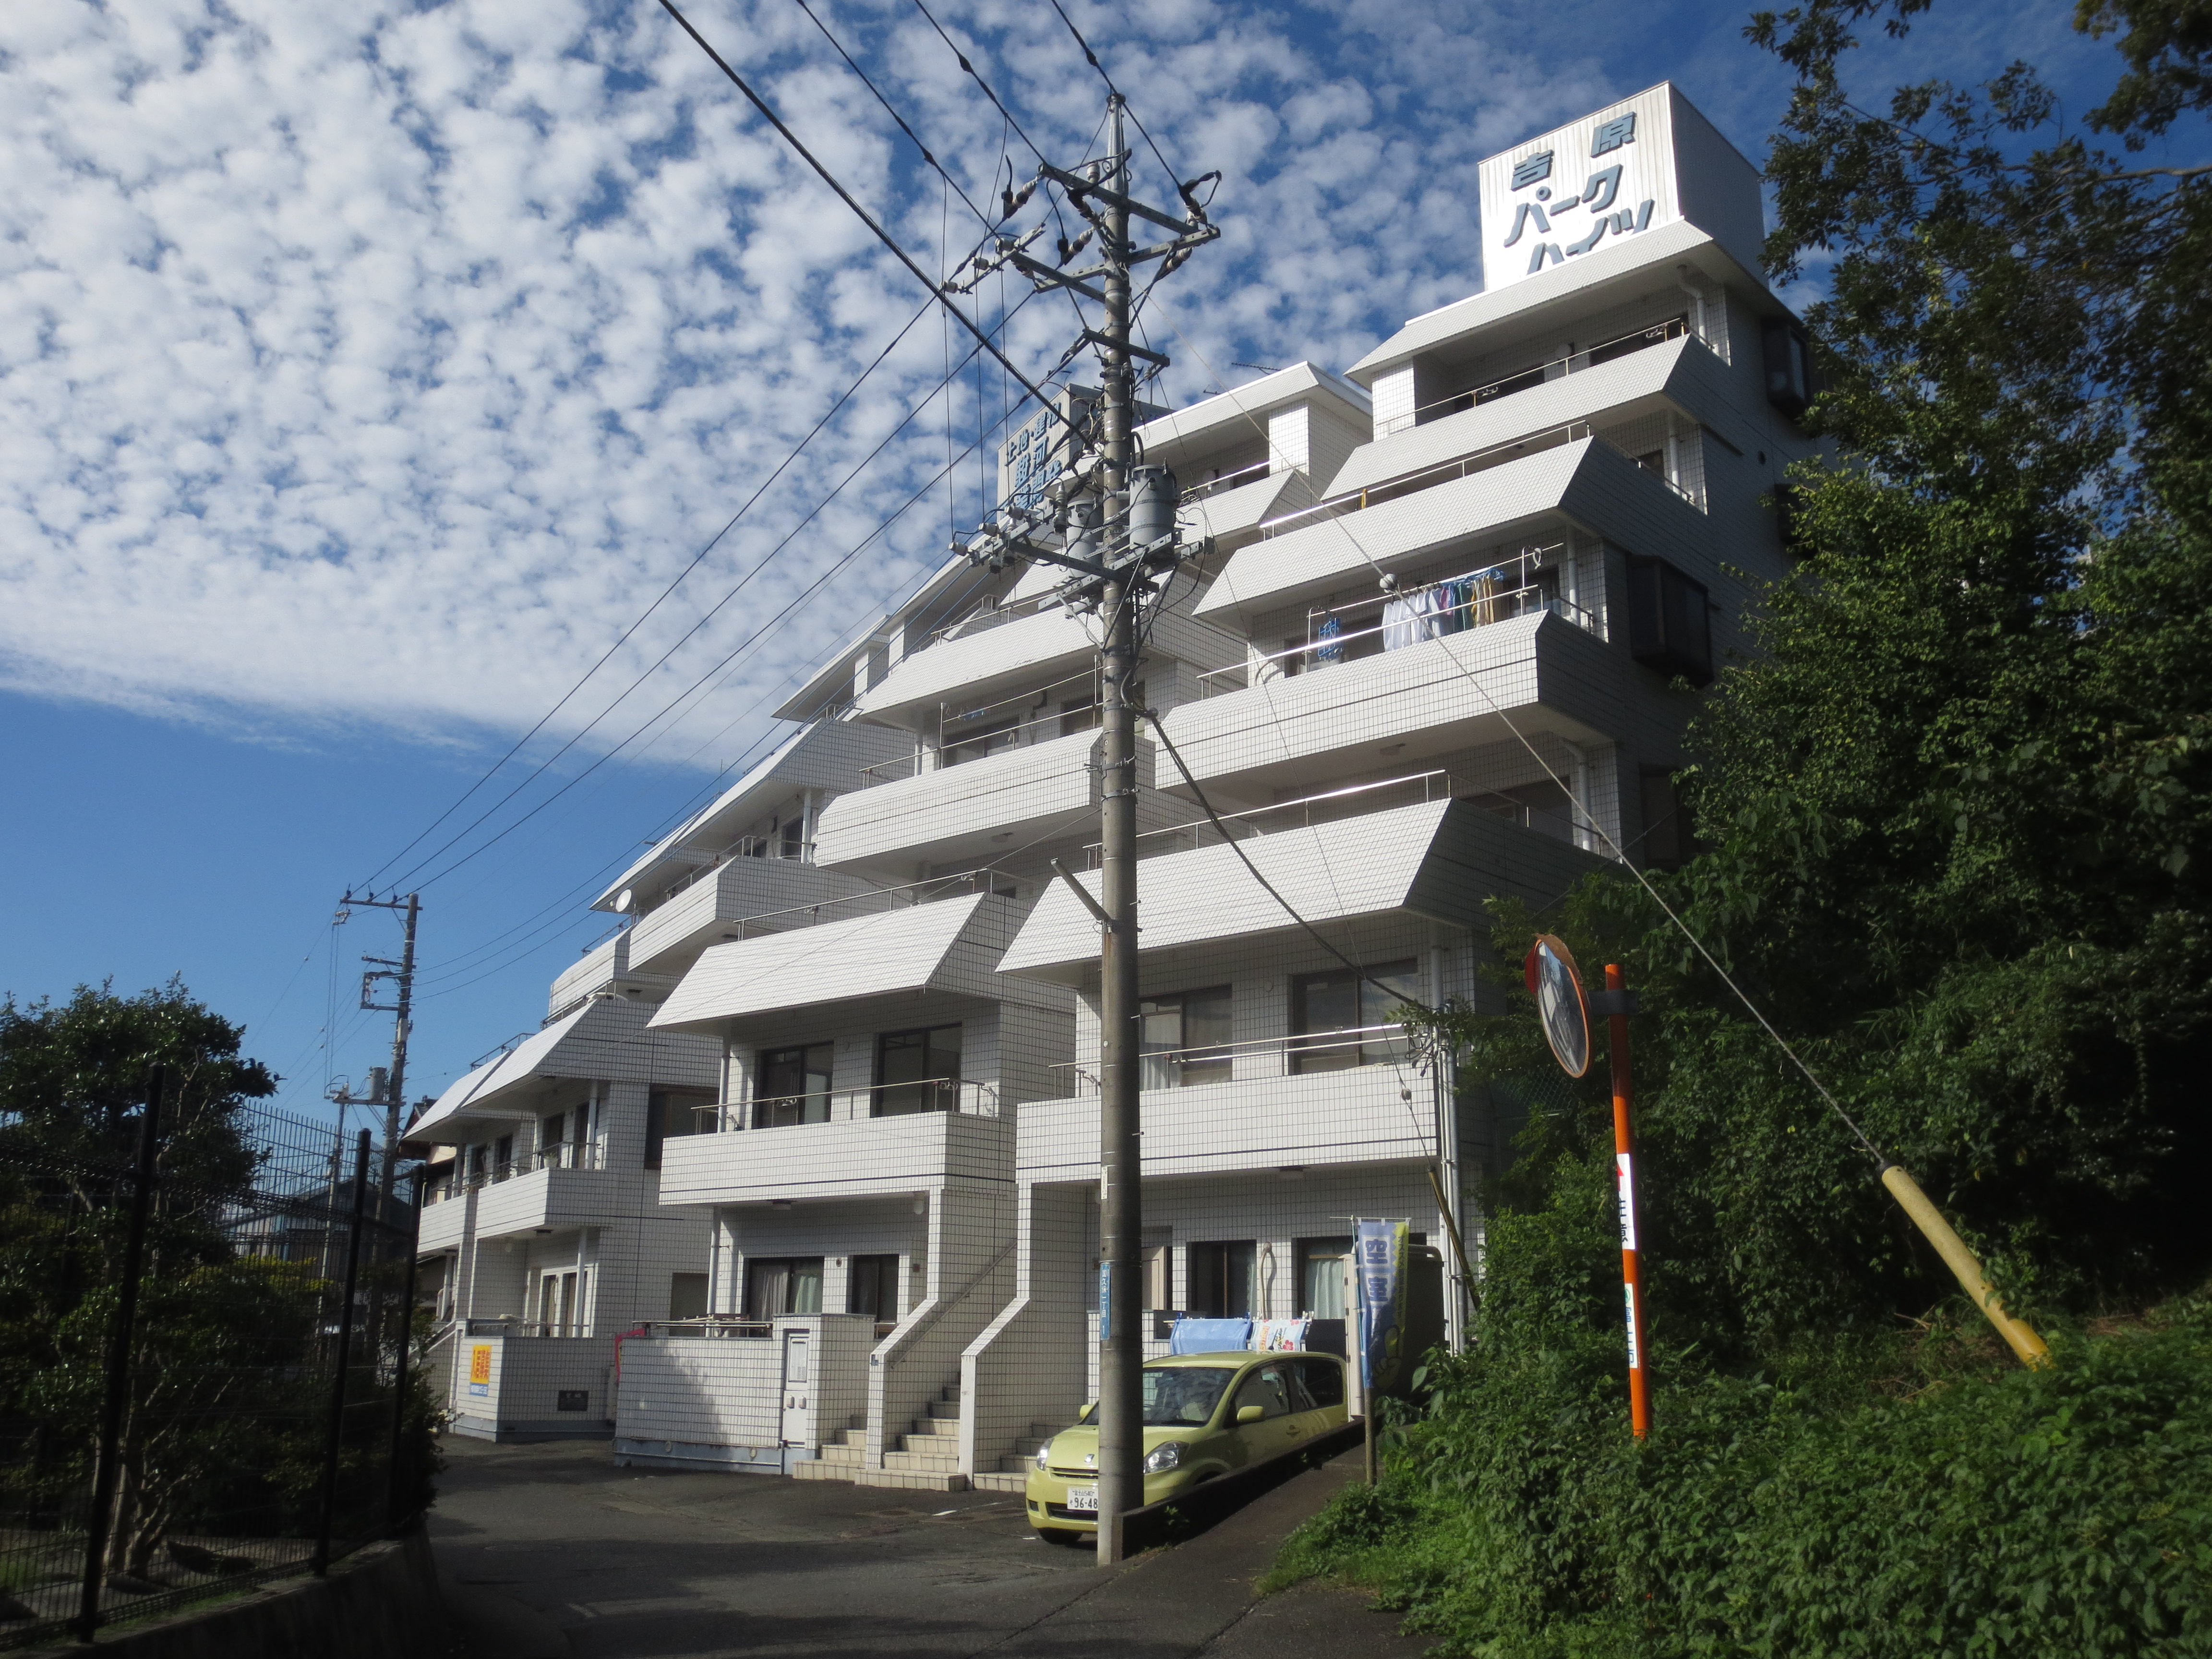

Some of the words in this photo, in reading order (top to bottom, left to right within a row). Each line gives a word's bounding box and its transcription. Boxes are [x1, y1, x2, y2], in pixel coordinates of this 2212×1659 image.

[1511, 111, 1637, 192] 吉原
[1503, 164, 1623, 248] パーク
[1527, 199, 1655, 276] ハイツ
[1365, 1238, 1388, 1302] 空室
[1074, 1497, 1098, 1509] 96-48
